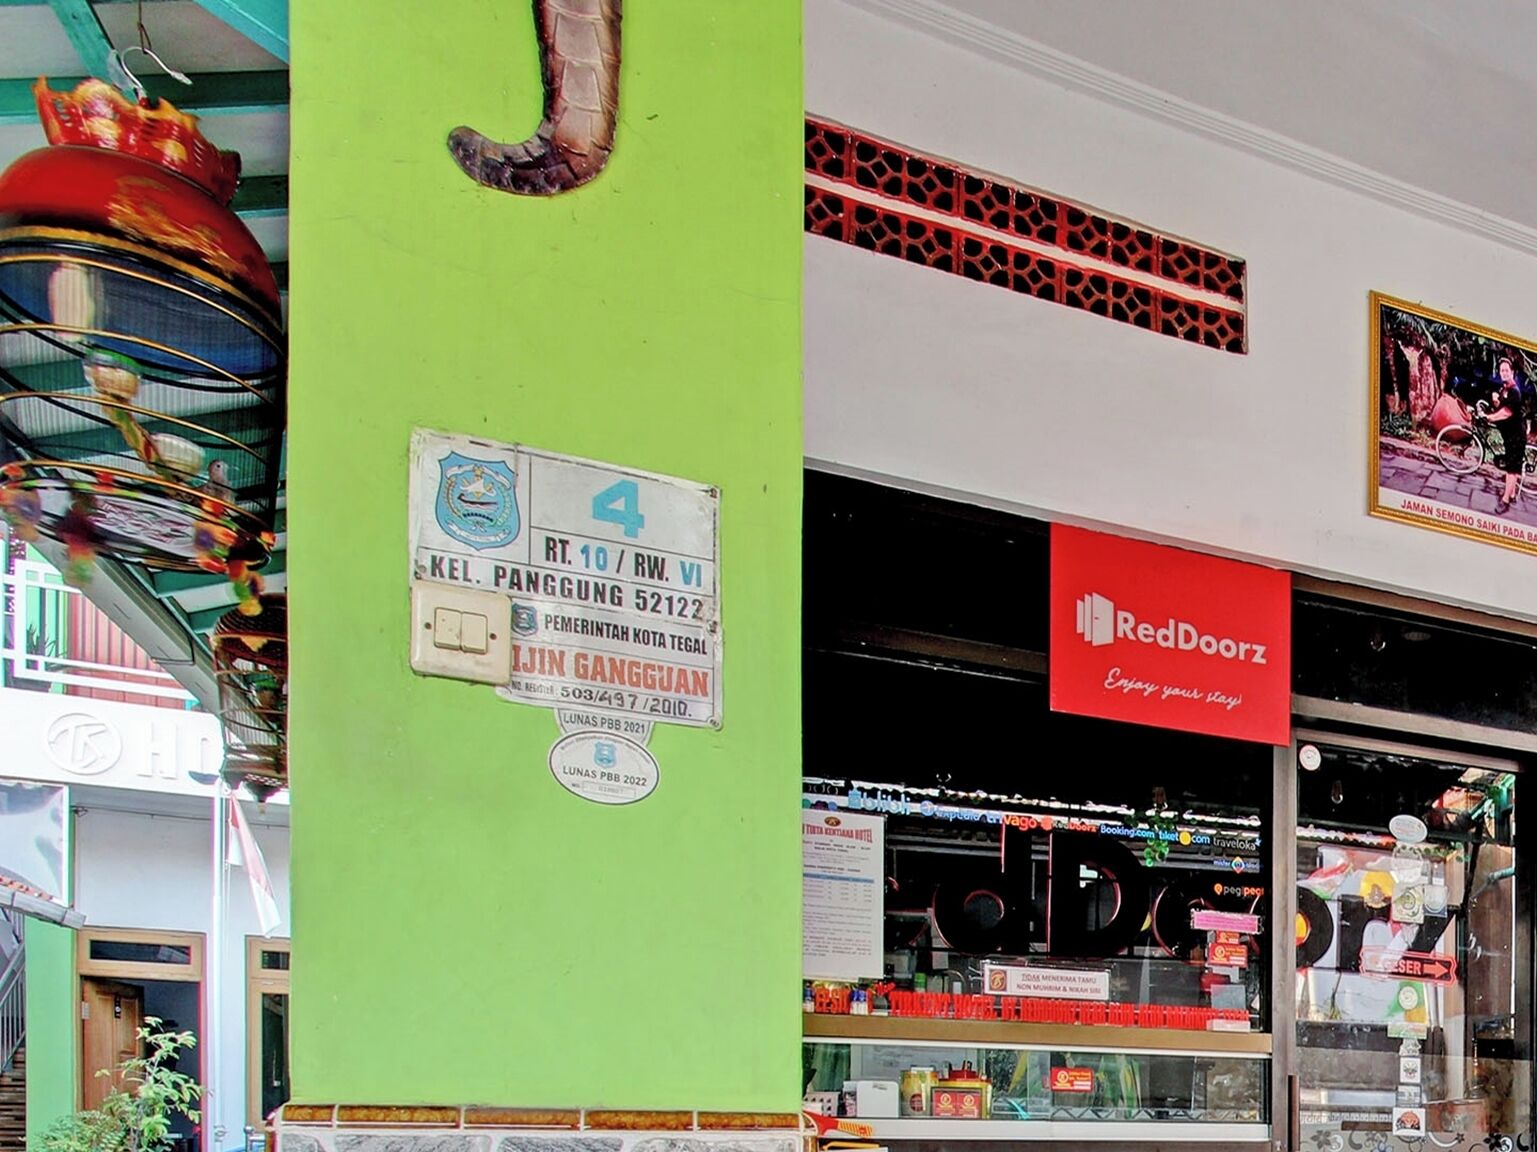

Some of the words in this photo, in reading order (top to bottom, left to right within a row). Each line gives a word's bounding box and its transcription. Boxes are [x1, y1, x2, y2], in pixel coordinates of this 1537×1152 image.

[592, 479, 644, 538] 4
[1401, 499, 1433, 516] JAMAN
[1436, 508, 1474, 526] SEMONO
[1477, 517, 1501, 533] SAIKI
[1503, 524, 1525, 539] PADA
[545, 535, 571, 565] RT.
[580, 544, 607, 571] 10
[635, 554, 669, 582] RW.
[680, 560, 702, 587] VI
[430, 554, 480, 584] KEL.
[494, 565, 623, 611] PANGGUNG
[635, 591, 703, 620] 52122
[544, 614, 629, 642] PEMERINTAH
[633, 627, 667, 649] KOTA
[670, 632, 707, 655] TEGAL
[1116, 610, 1267, 664] RedDoorz
[512, 643, 565, 677] IJIN
[574, 653, 709, 697] GANGGUAN
[1104, 667, 1159, 696] Enjoy
[1162, 685, 1203, 699] your
[563, 712, 598, 728] LUNAS
[600, 717, 621, 731] PBB
[624, 719, 645, 735] 2021
[563, 766, 597, 778] LUNAS
[600, 771, 620, 782] PBB
[624, 775, 647, 786] 2022
[1100, 825, 1154, 839] Booking.com
[1213, 837, 1256, 850] traveloka
